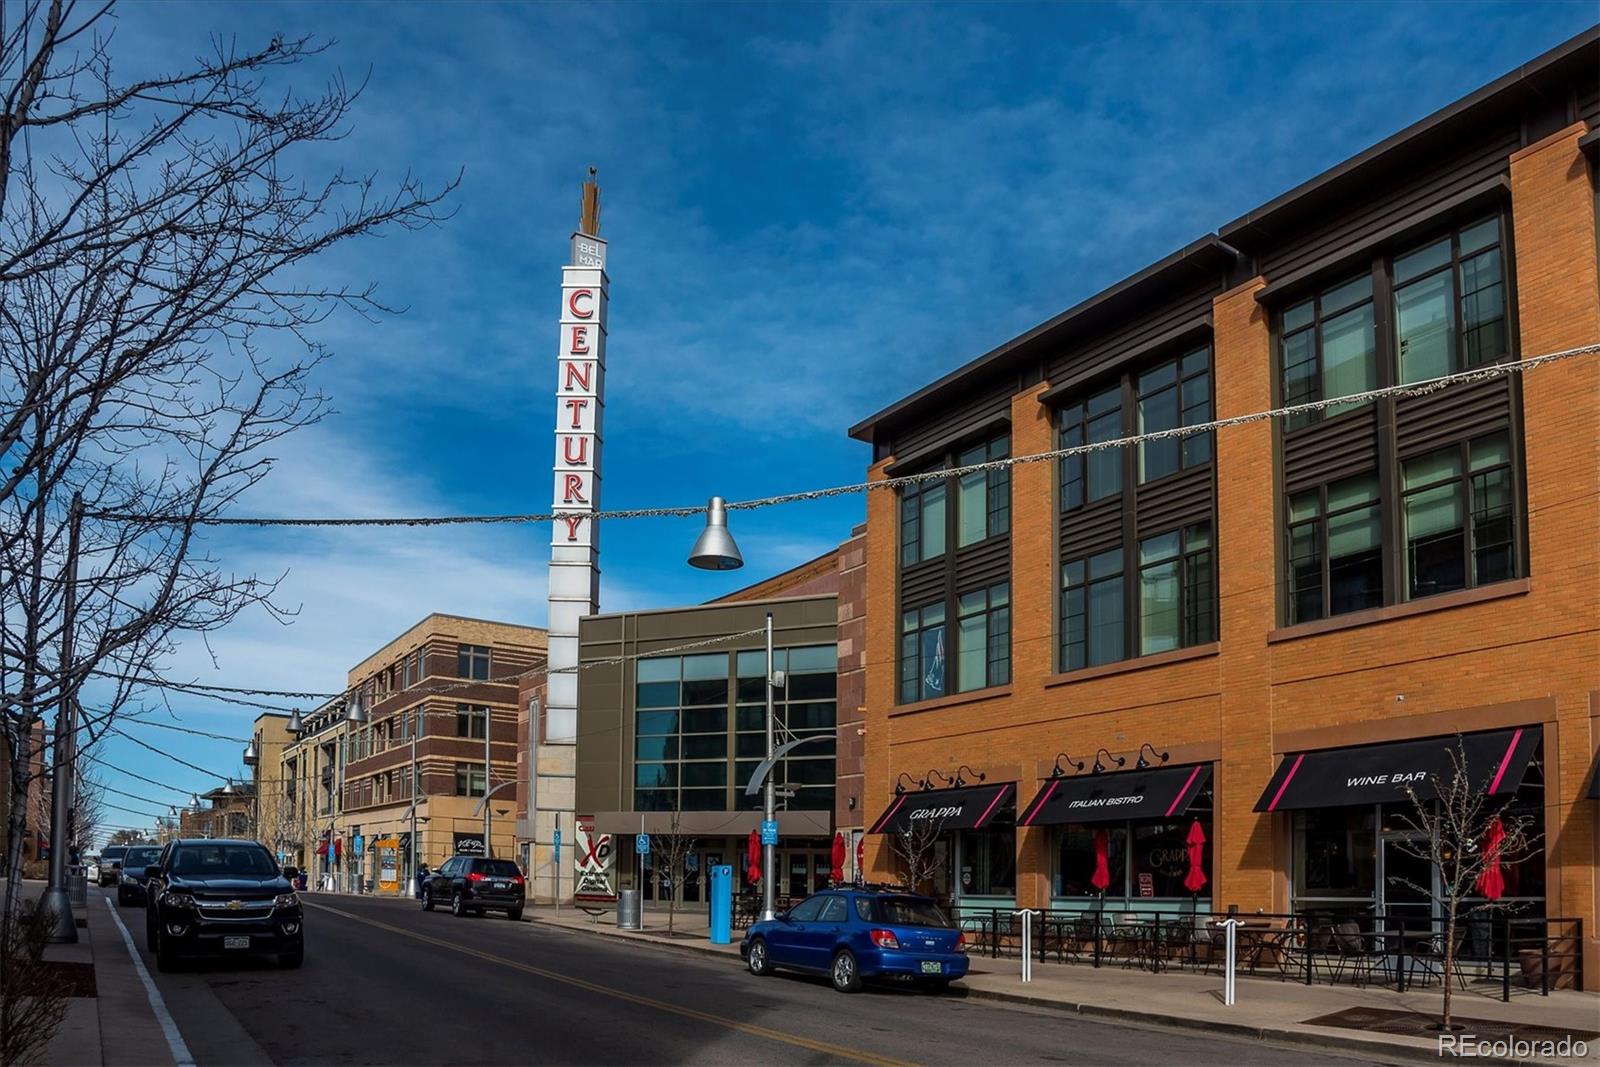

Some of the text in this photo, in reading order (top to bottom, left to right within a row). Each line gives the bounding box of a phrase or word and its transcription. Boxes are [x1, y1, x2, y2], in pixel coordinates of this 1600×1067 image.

[577, 243, 602, 258] BEL
[563, 289, 594, 541] CENTURY
[1347, 771, 1427, 787] WINE BAR
[1068, 795, 1144, 809] ITALIAN BISTRO
[909, 806, 963, 820] GRAPPA
[1149, 847, 1188, 868] GRAPP
